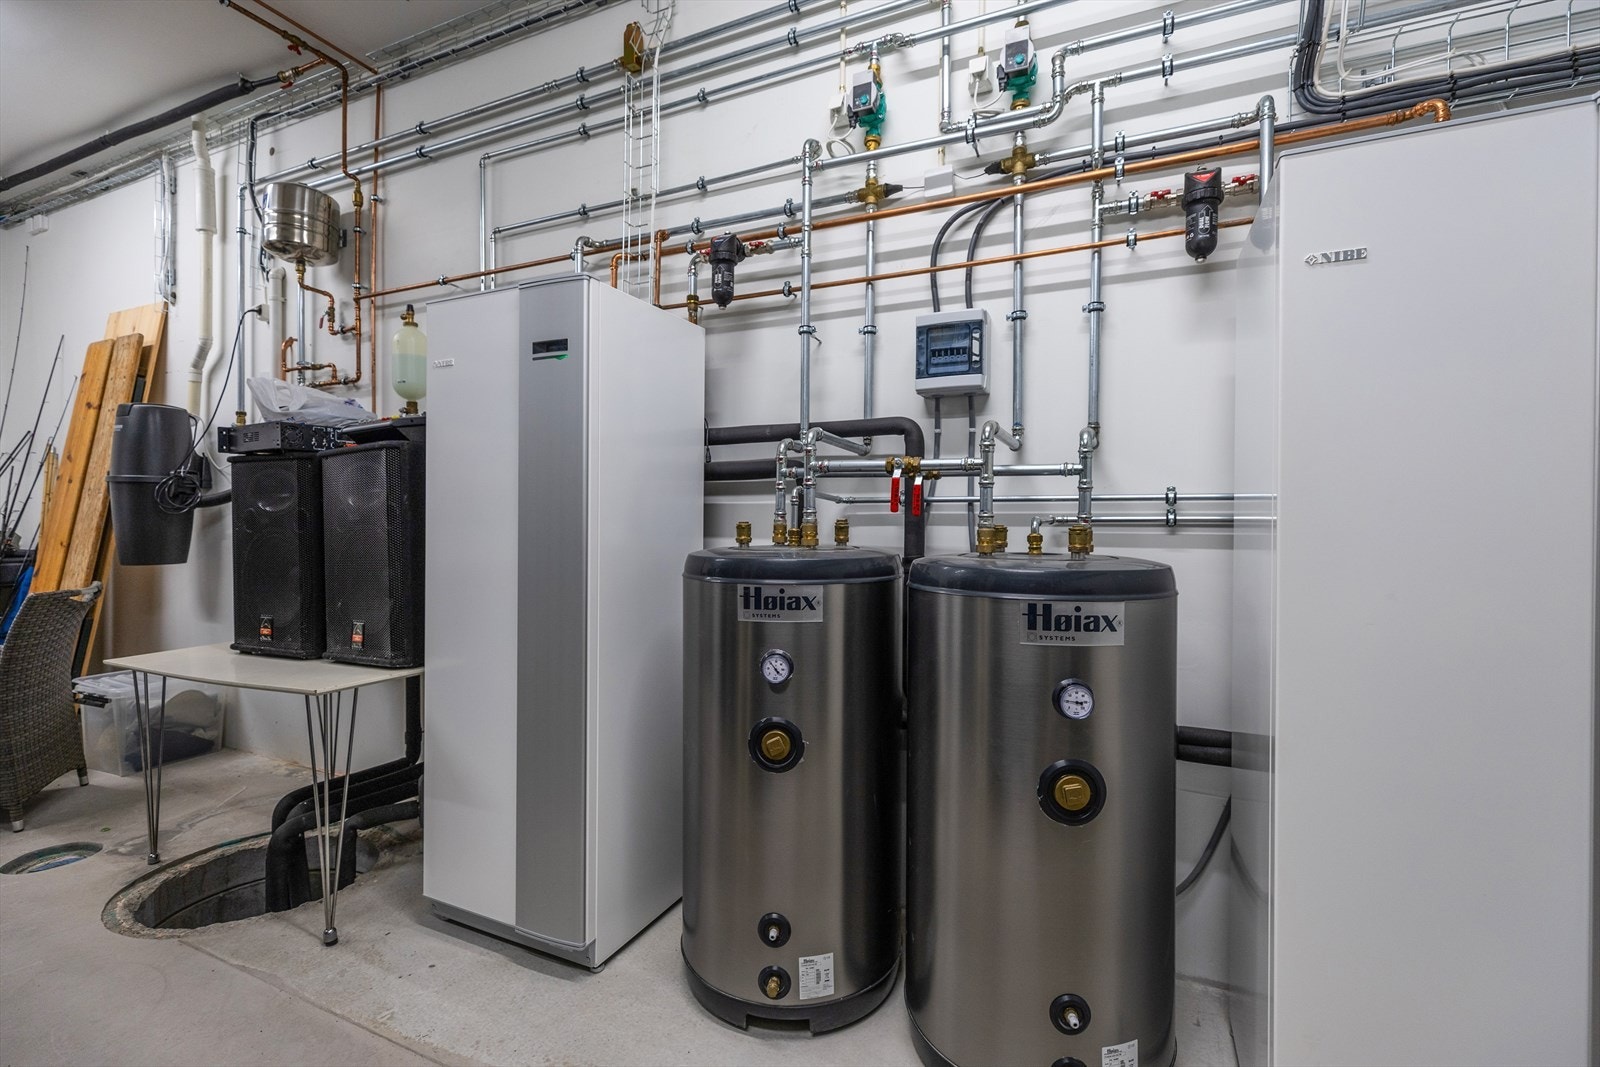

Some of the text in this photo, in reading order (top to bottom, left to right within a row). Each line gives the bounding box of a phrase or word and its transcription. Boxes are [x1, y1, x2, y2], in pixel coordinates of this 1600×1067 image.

[1317, 247, 1367, 264] NIBE
[739, 586, 817, 611] Høiax
[1022, 603, 1118, 632] Høiax
